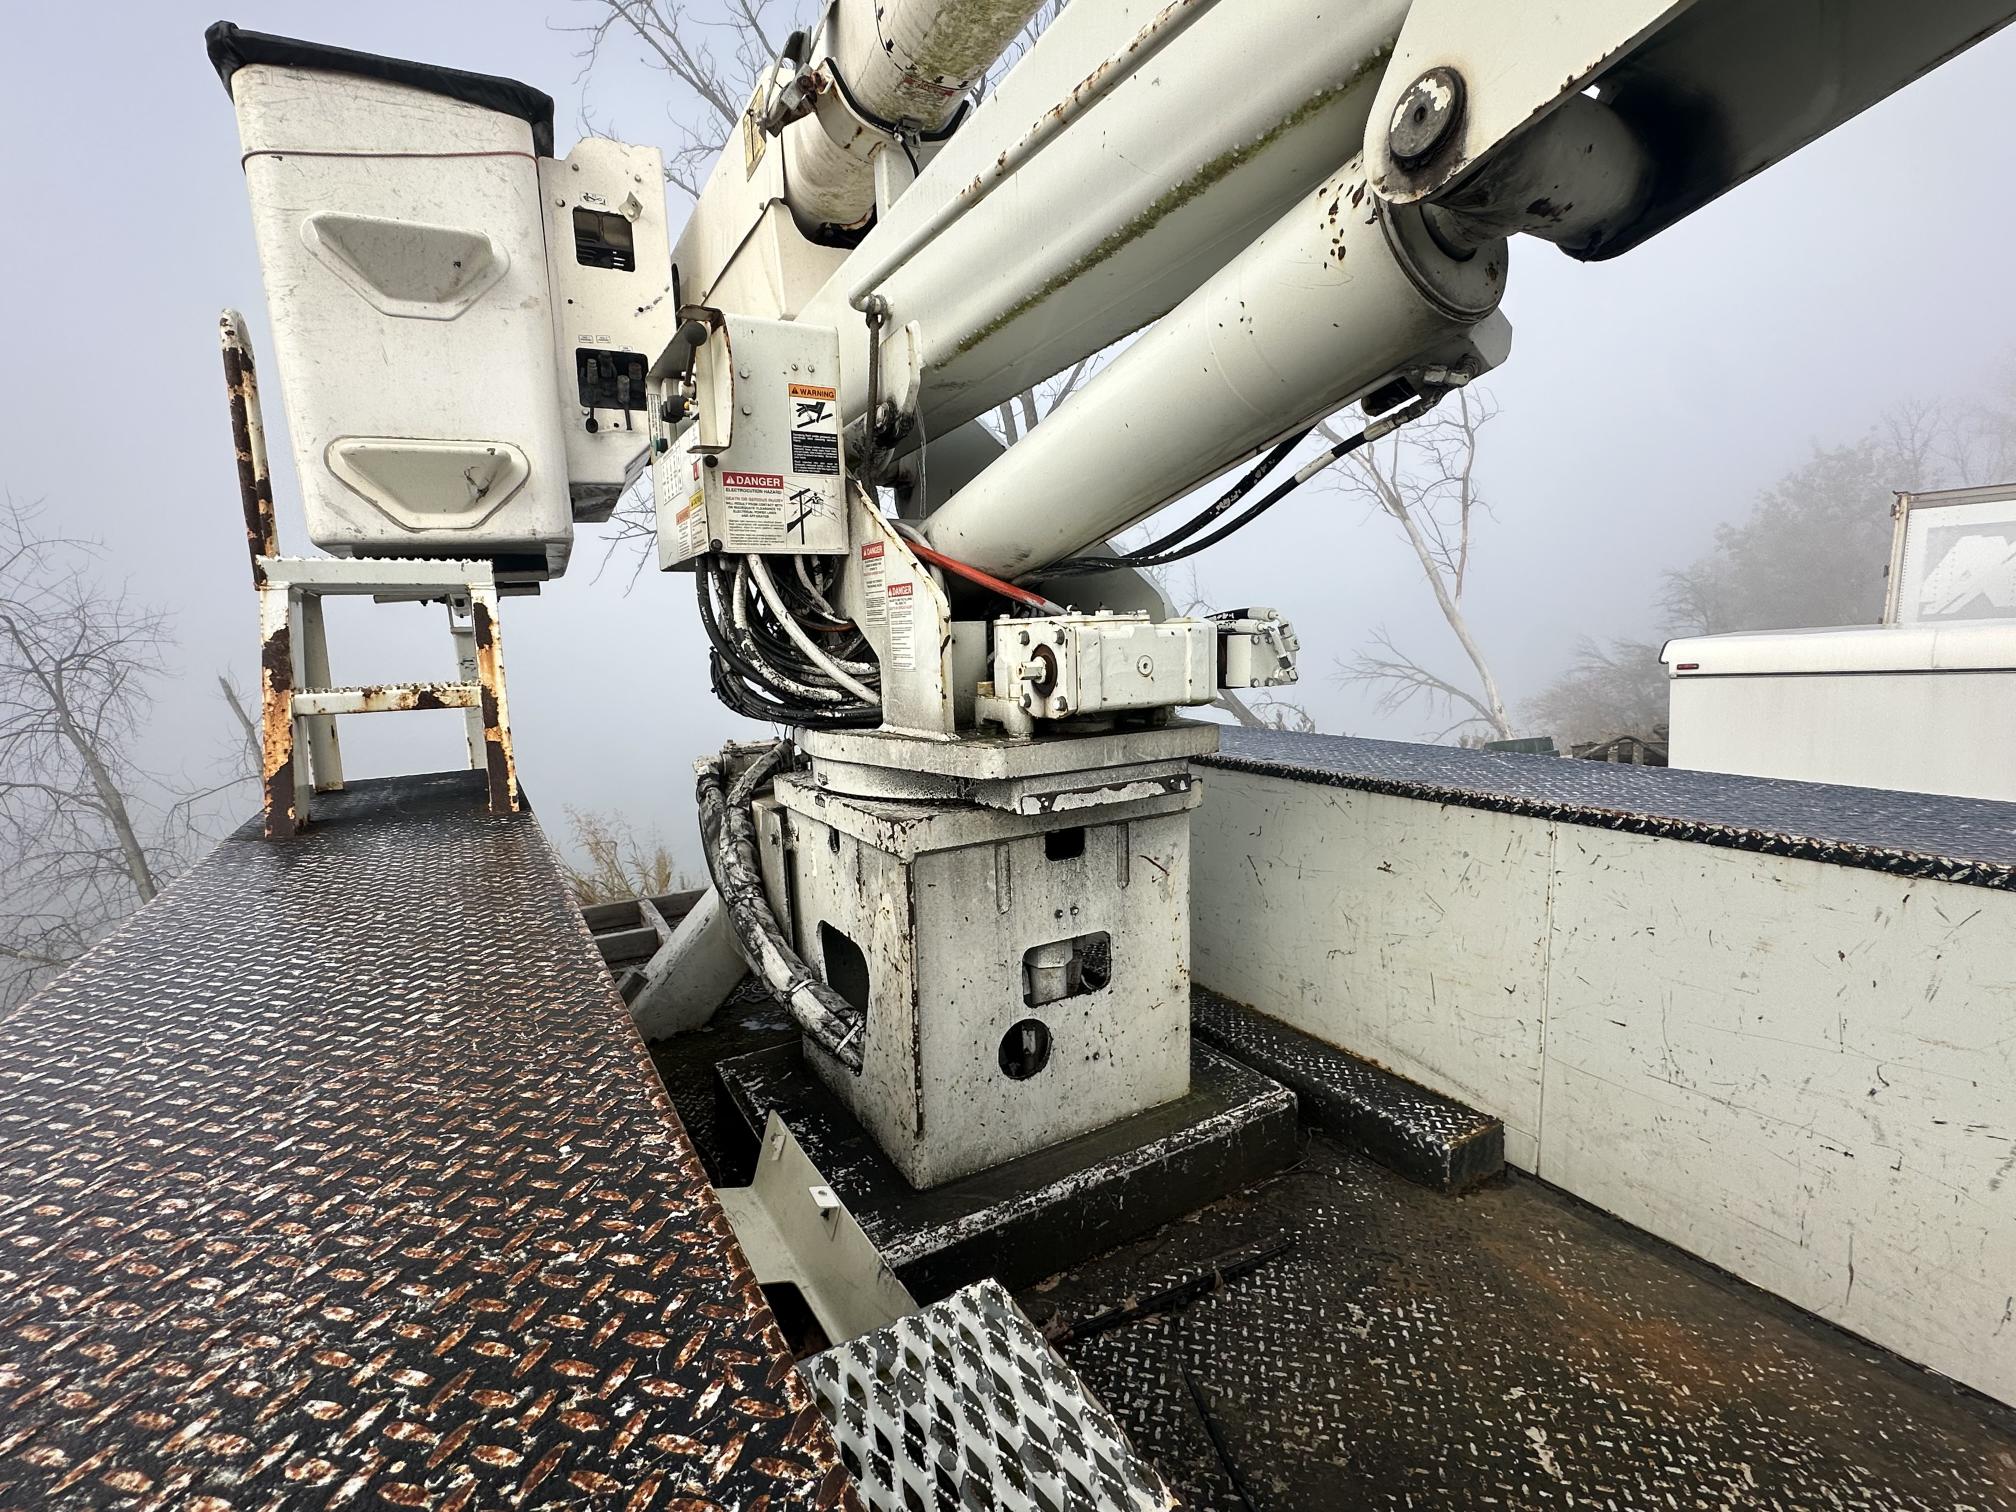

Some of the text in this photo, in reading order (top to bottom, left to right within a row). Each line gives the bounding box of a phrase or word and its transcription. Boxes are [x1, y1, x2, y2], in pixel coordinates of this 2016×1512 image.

[800, 389, 834, 398] WARNING
[736, 476, 780, 486] DANGER
[866, 544, 883, 556] DANGER
[892, 585, 912, 597] DANGER
